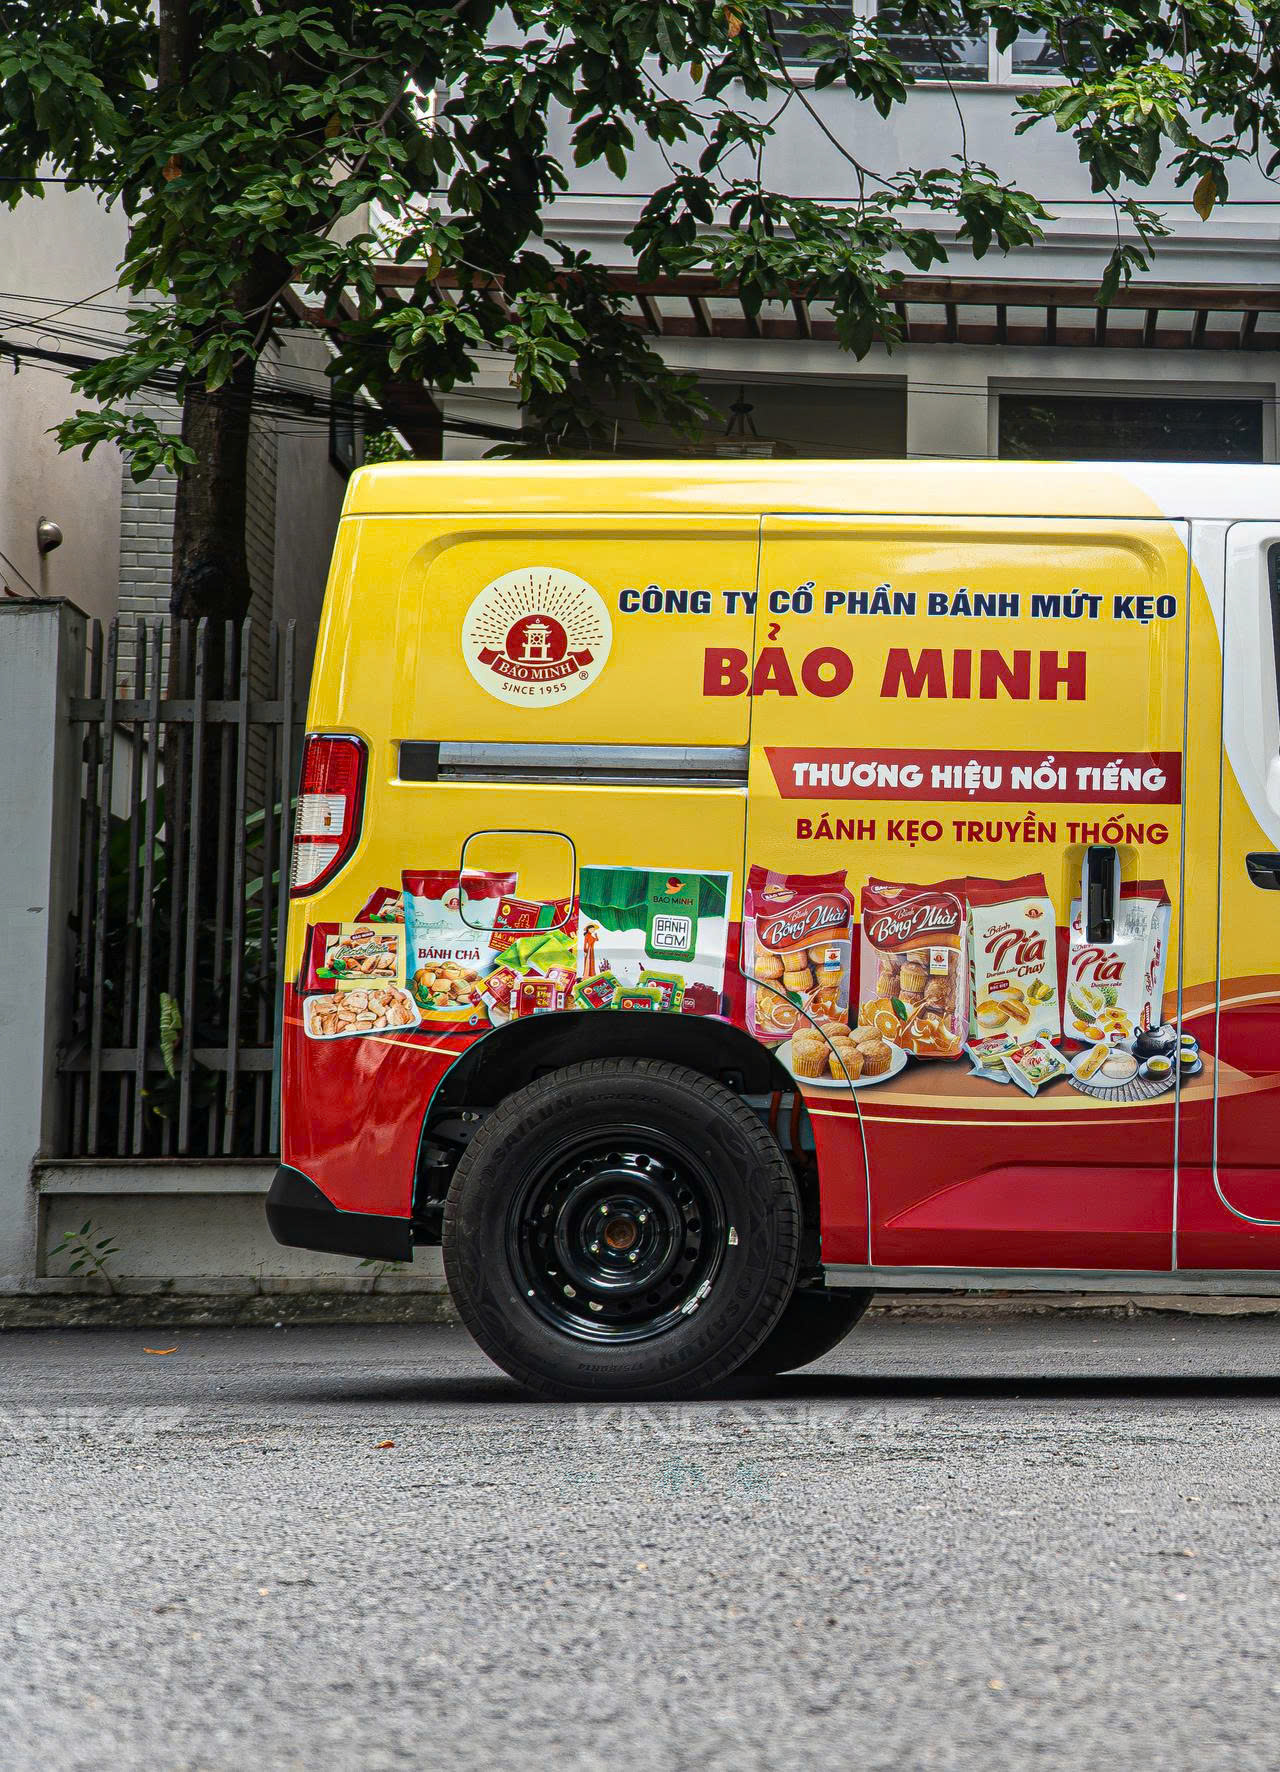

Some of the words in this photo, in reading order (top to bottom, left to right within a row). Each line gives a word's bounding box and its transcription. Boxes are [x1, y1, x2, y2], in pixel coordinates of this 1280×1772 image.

[618, 585, 712, 615] CÔNG
[722, 590, 758, 615] TY
[768, 581, 815, 616] CỔ
[824, 583, 916, 616] PHẦN
[928, 587, 1020, 618] BÁNH
[1031, 588, 1103, 619] MỨT
[1112, 594, 1177, 625] KẸO
[499, 662, 528, 679] BẢO
[531, 663, 572, 679] MINH
[703, 622, 854, 698] BẢO
[879, 647, 1087, 701] MINH
[502, 682, 535, 695] SINCE
[540, 682, 567, 694] 1955
[792, 761, 924, 788] THƯƠNG
[931, 760, 1002, 795] HIỆU
[1011, 756, 1067, 791] NỔI
[1076, 759, 1167, 792] TIẾNG
[796, 812, 876, 840] BÁNH
[887, 819, 944, 848] KẸO
[953, 810, 1057, 844] TRUYỀN
[1066, 813, 1169, 845] THỐNG
[418, 945, 452, 960] BÁNH
[1017, 962, 1045, 977] Chay
